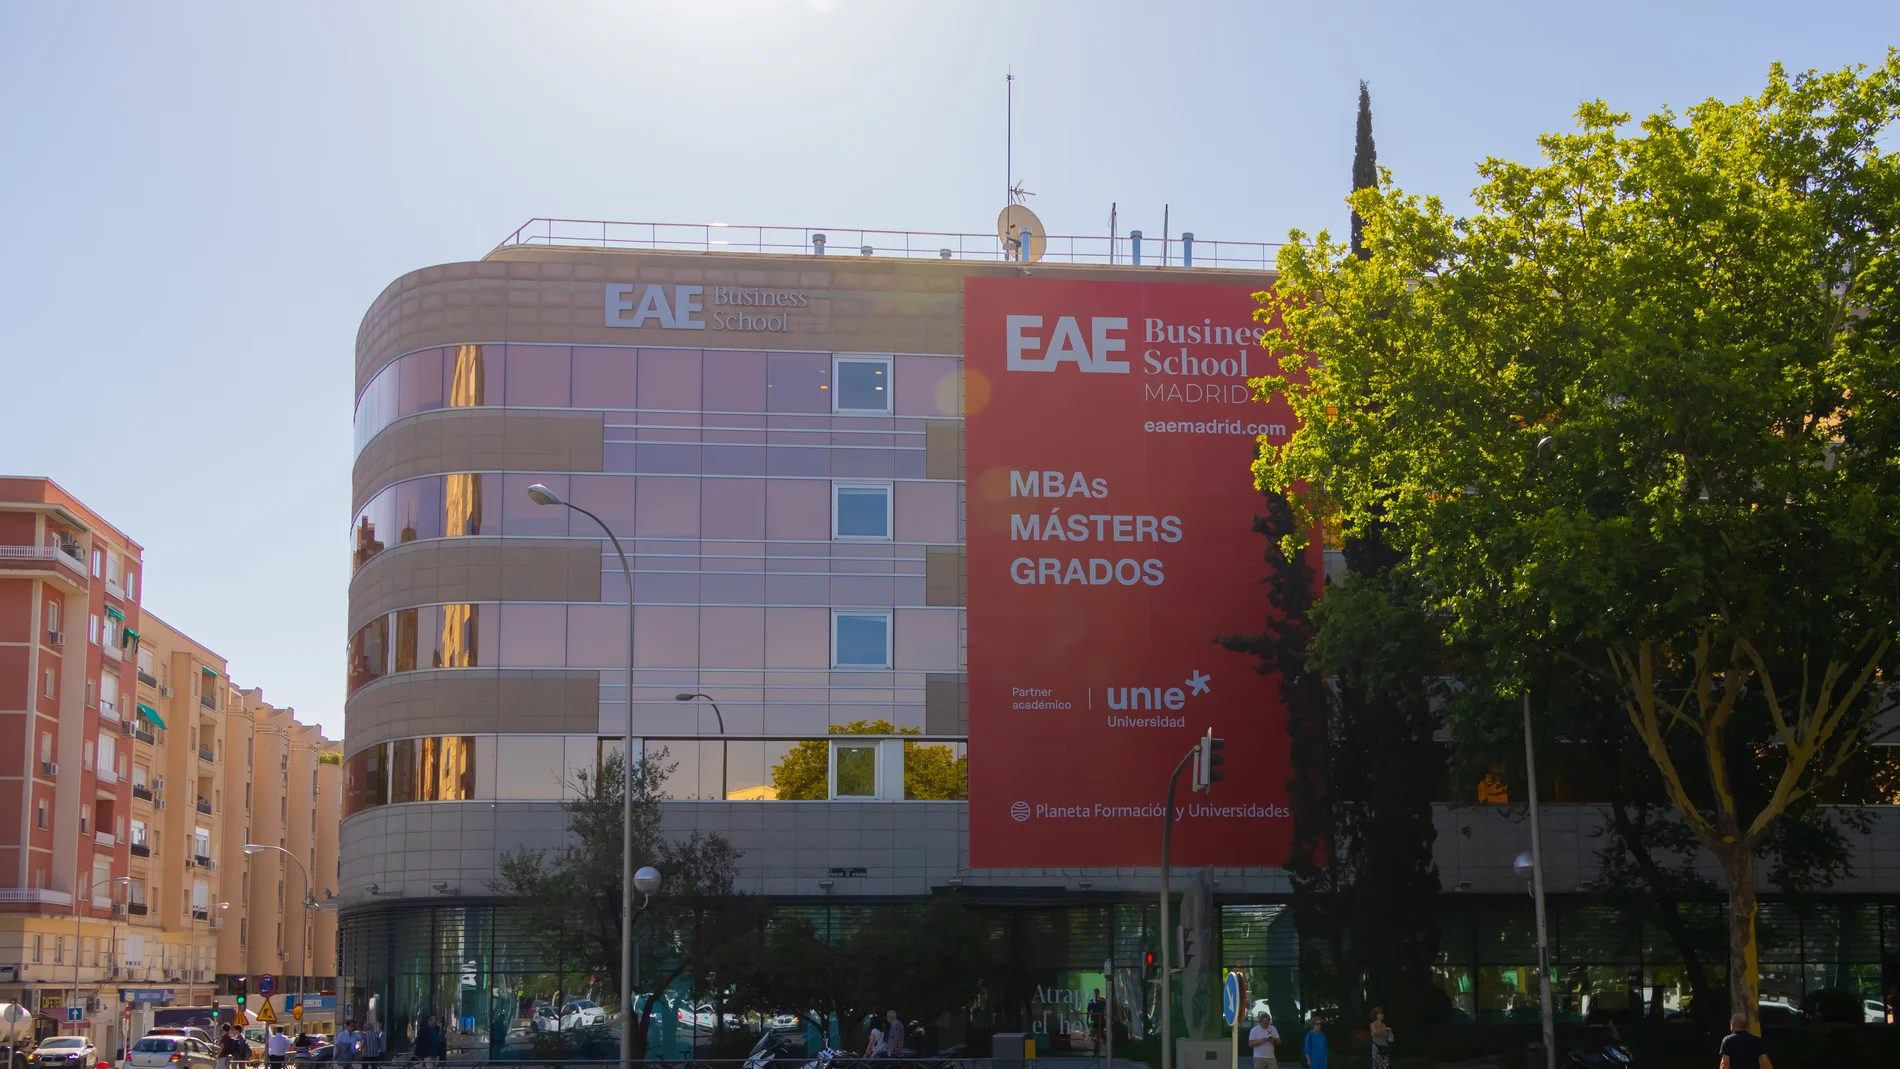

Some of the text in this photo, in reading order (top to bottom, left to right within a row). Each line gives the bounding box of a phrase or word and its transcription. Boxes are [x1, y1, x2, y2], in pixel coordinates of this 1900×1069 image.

[604, 283, 706, 329] EAE
[713, 286, 808, 308] Business
[713, 311, 789, 332] School
[1006, 314, 1130, 374] EAE
[1144, 348, 1249, 377] School
[1145, 383, 1249, 404] MADRID
[1144, 419, 1286, 436] eaemadrid.com
[1010, 470, 1109, 498] MBAs
[1010, 507, 1183, 543] MÁSTERS
[1010, 557, 1165, 586] GRADOS
[1012, 687, 1053, 697] Partner
[1012, 699, 1072, 710] académico
[1107, 715, 1185, 727] Universidad
[1036, 803, 1090, 818] Planeta
[1175, 807, 1185, 821] y
[1189, 801, 1290, 818] Universidades
[1032, 984, 1098, 1010] Atrapa
[1032, 1012, 1094, 1041] el hoy
